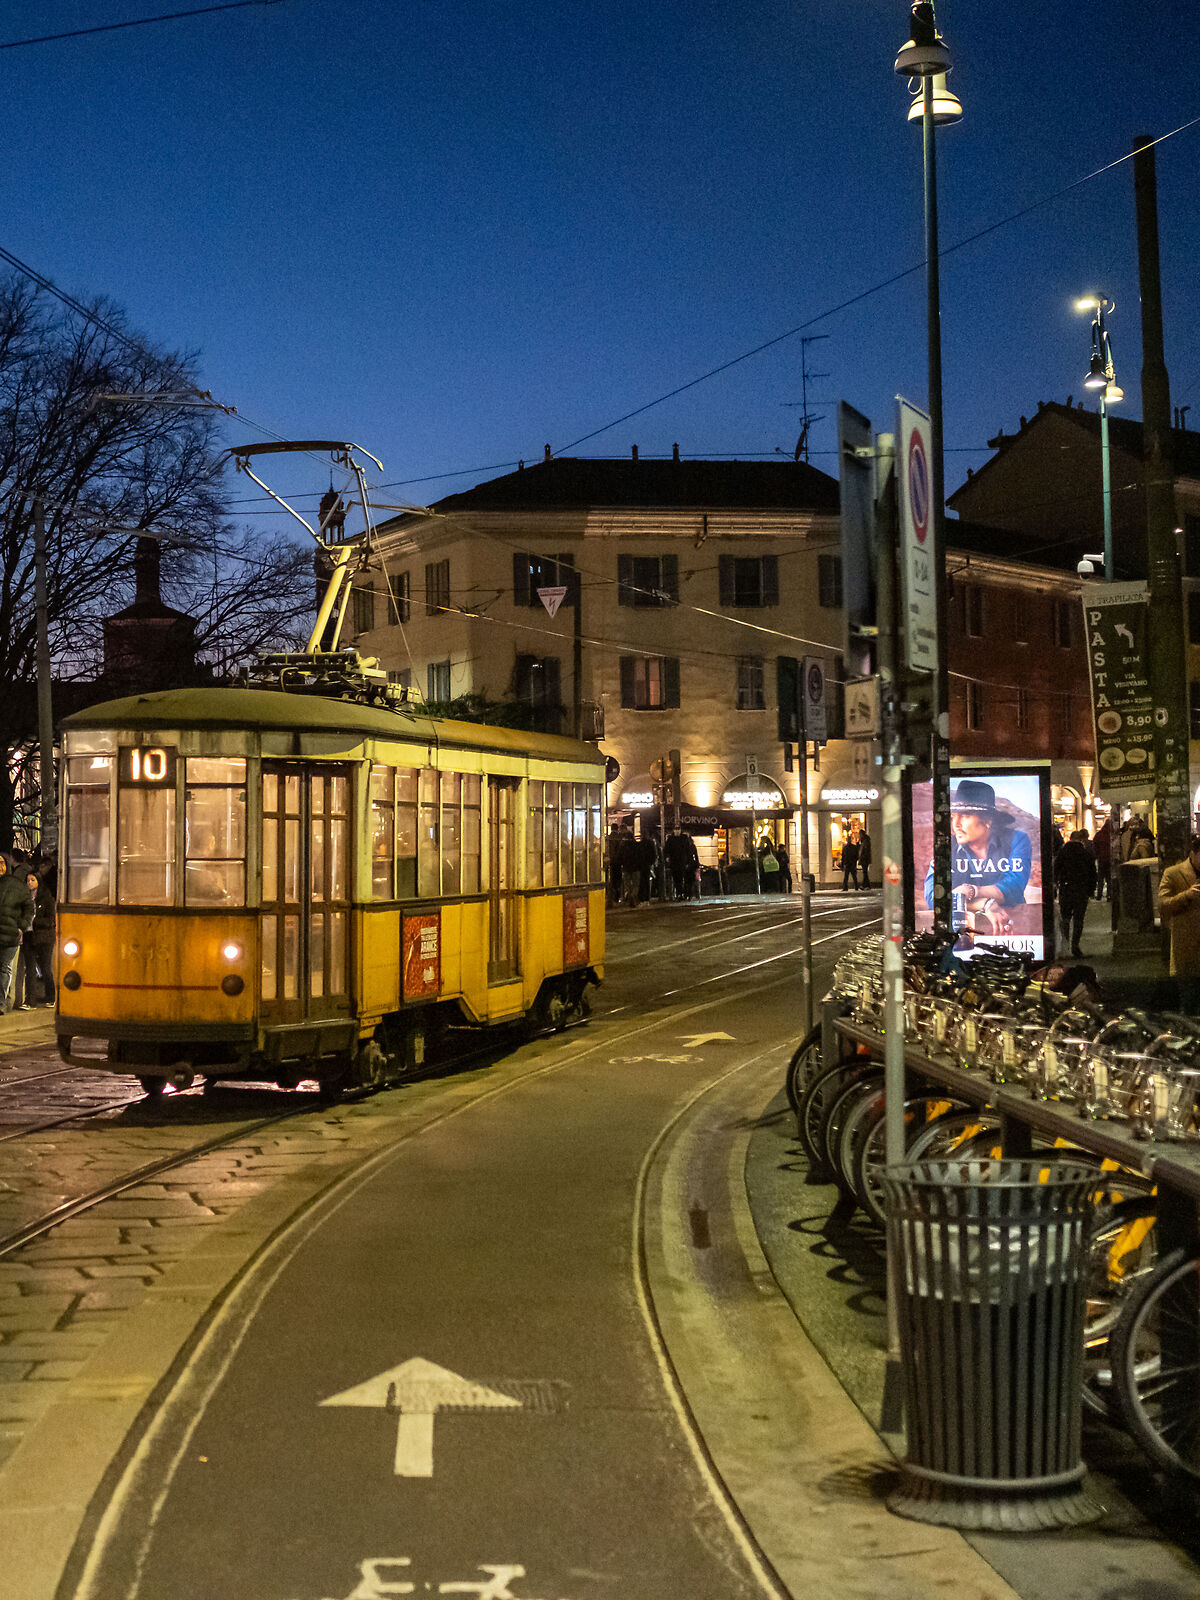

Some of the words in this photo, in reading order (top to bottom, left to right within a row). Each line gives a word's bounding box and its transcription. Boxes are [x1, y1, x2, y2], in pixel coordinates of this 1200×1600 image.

[1089, 611, 1111, 708] PASTA
[131, 748, 167, 781] 10
[622, 793, 654, 803] SIGNO
